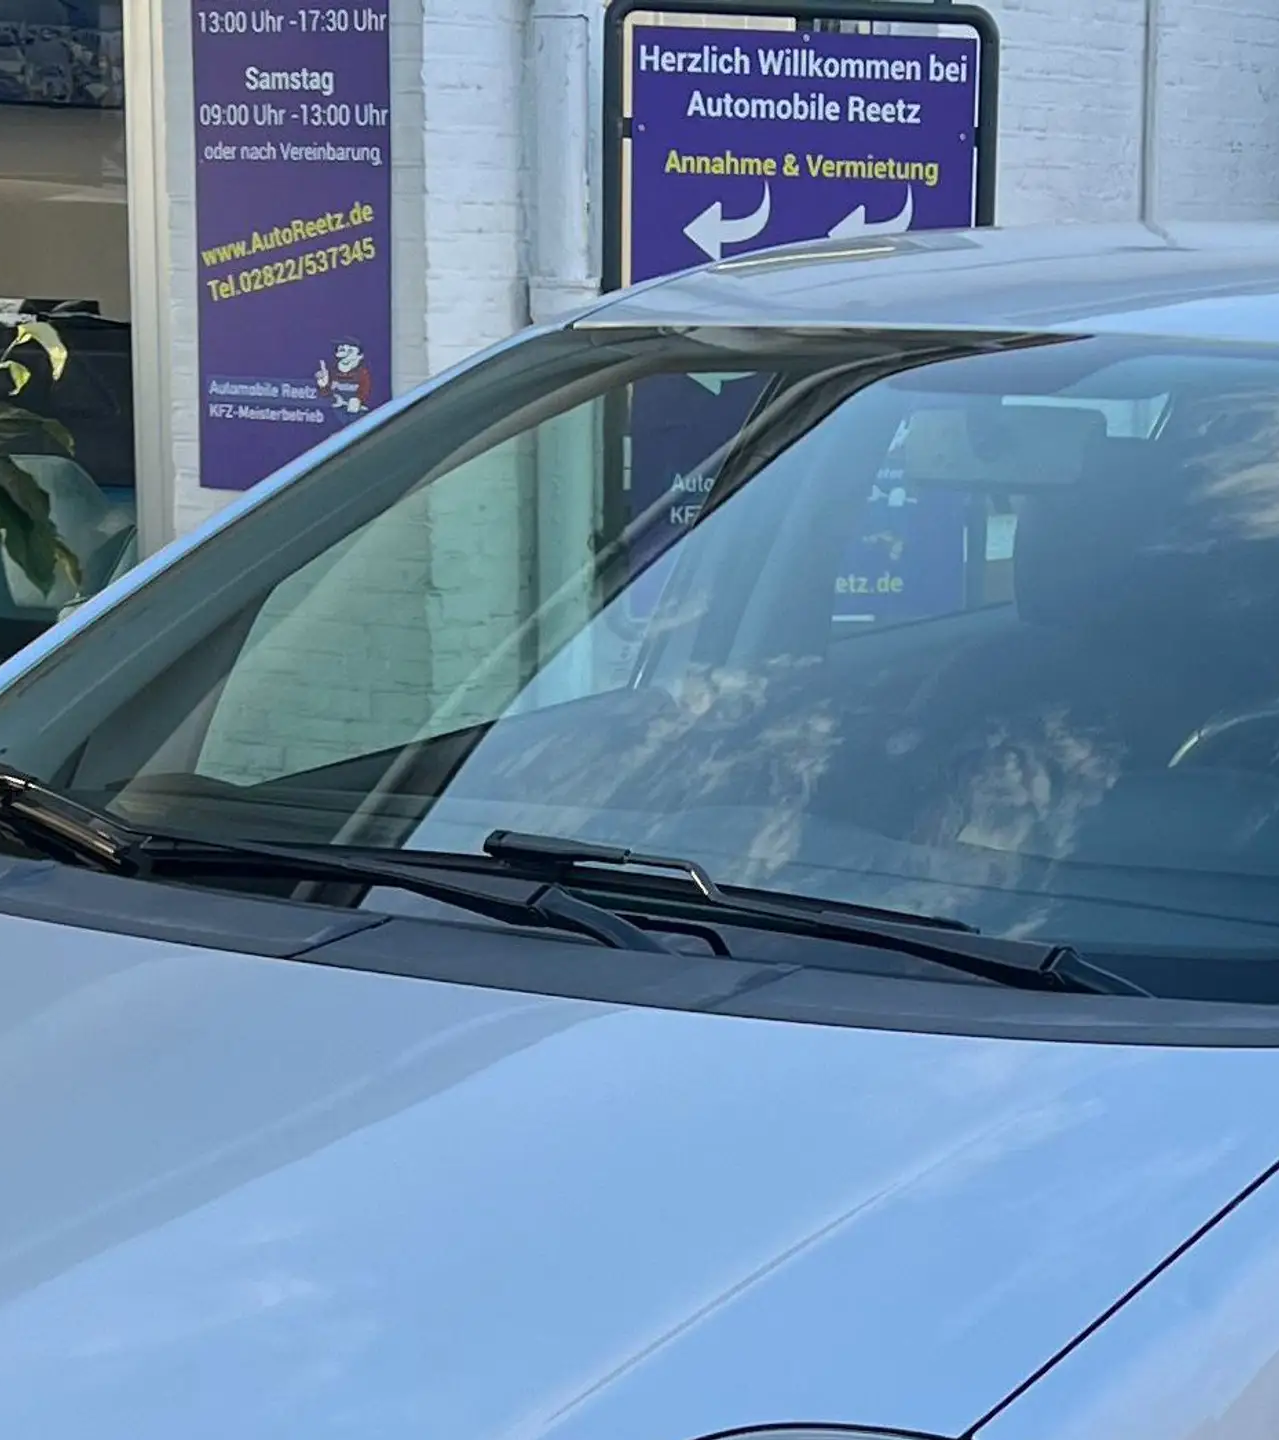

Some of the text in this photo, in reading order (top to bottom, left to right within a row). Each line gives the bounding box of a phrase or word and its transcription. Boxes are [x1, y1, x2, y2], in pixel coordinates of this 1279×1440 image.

[198, 10, 247, 33] 13:00
[251, 9, 285, 33] Uhr
[353, 7, 387, 32] Uhr
[639, 45, 968, 83] Herzlich Willkommen bei
[244, 66, 334, 96] Samstag
[199, 103, 250, 127] 09:00
[253, 103, 286, 127] Uhr
[354, 102, 389, 127] Uhr
[686, 90, 922, 124] Automobile Reetz
[203, 141, 382, 167] oder nach Vereinbarung
[664, 149, 939, 186] Annahme & Vermietung
[201, 200, 375, 267] www.AutoReetz.de
[206, 236, 376, 302] Tel.02822/537345
[208, 379, 318, 400] Automobile Reetz
[208, 403, 325, 424] KFZ-Meisterbetrieb
[670, 472, 715, 493] Auto
[670, 505, 703, 525] KF
[834, 570, 904, 594] etz.de
